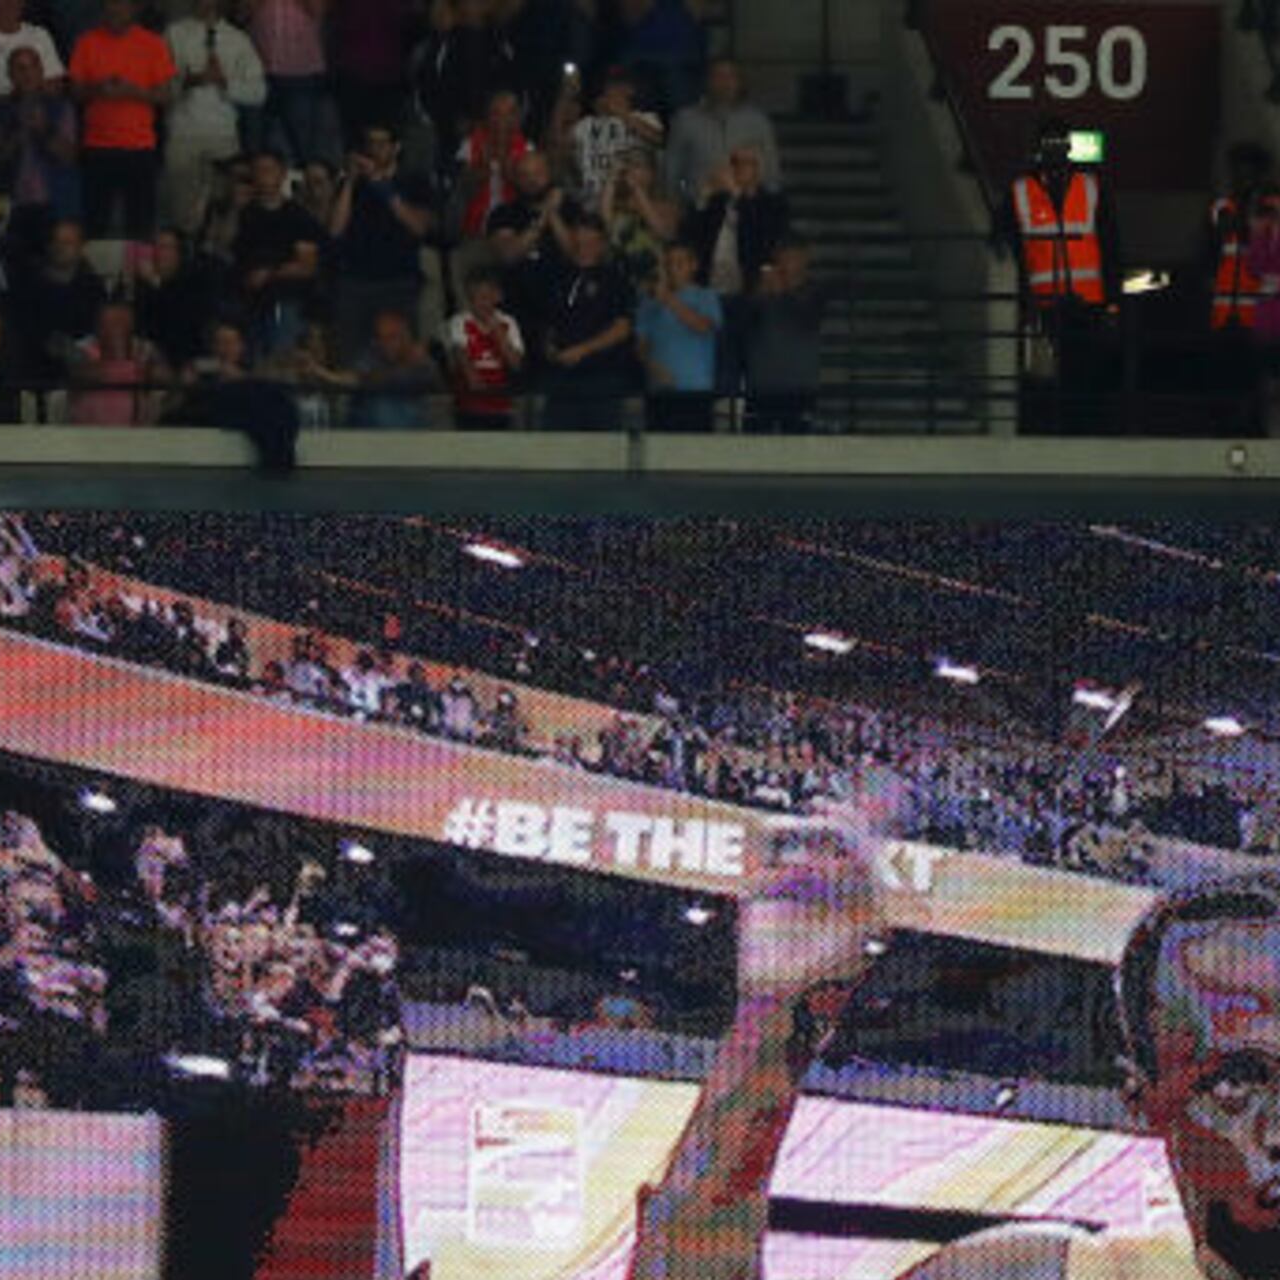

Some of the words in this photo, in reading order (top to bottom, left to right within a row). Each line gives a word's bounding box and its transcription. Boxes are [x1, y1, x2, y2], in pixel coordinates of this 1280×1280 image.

[988, 26, 1147, 99] 250
[443, 797, 593, 863] #BE
[606, 809, 746, 876] THE
